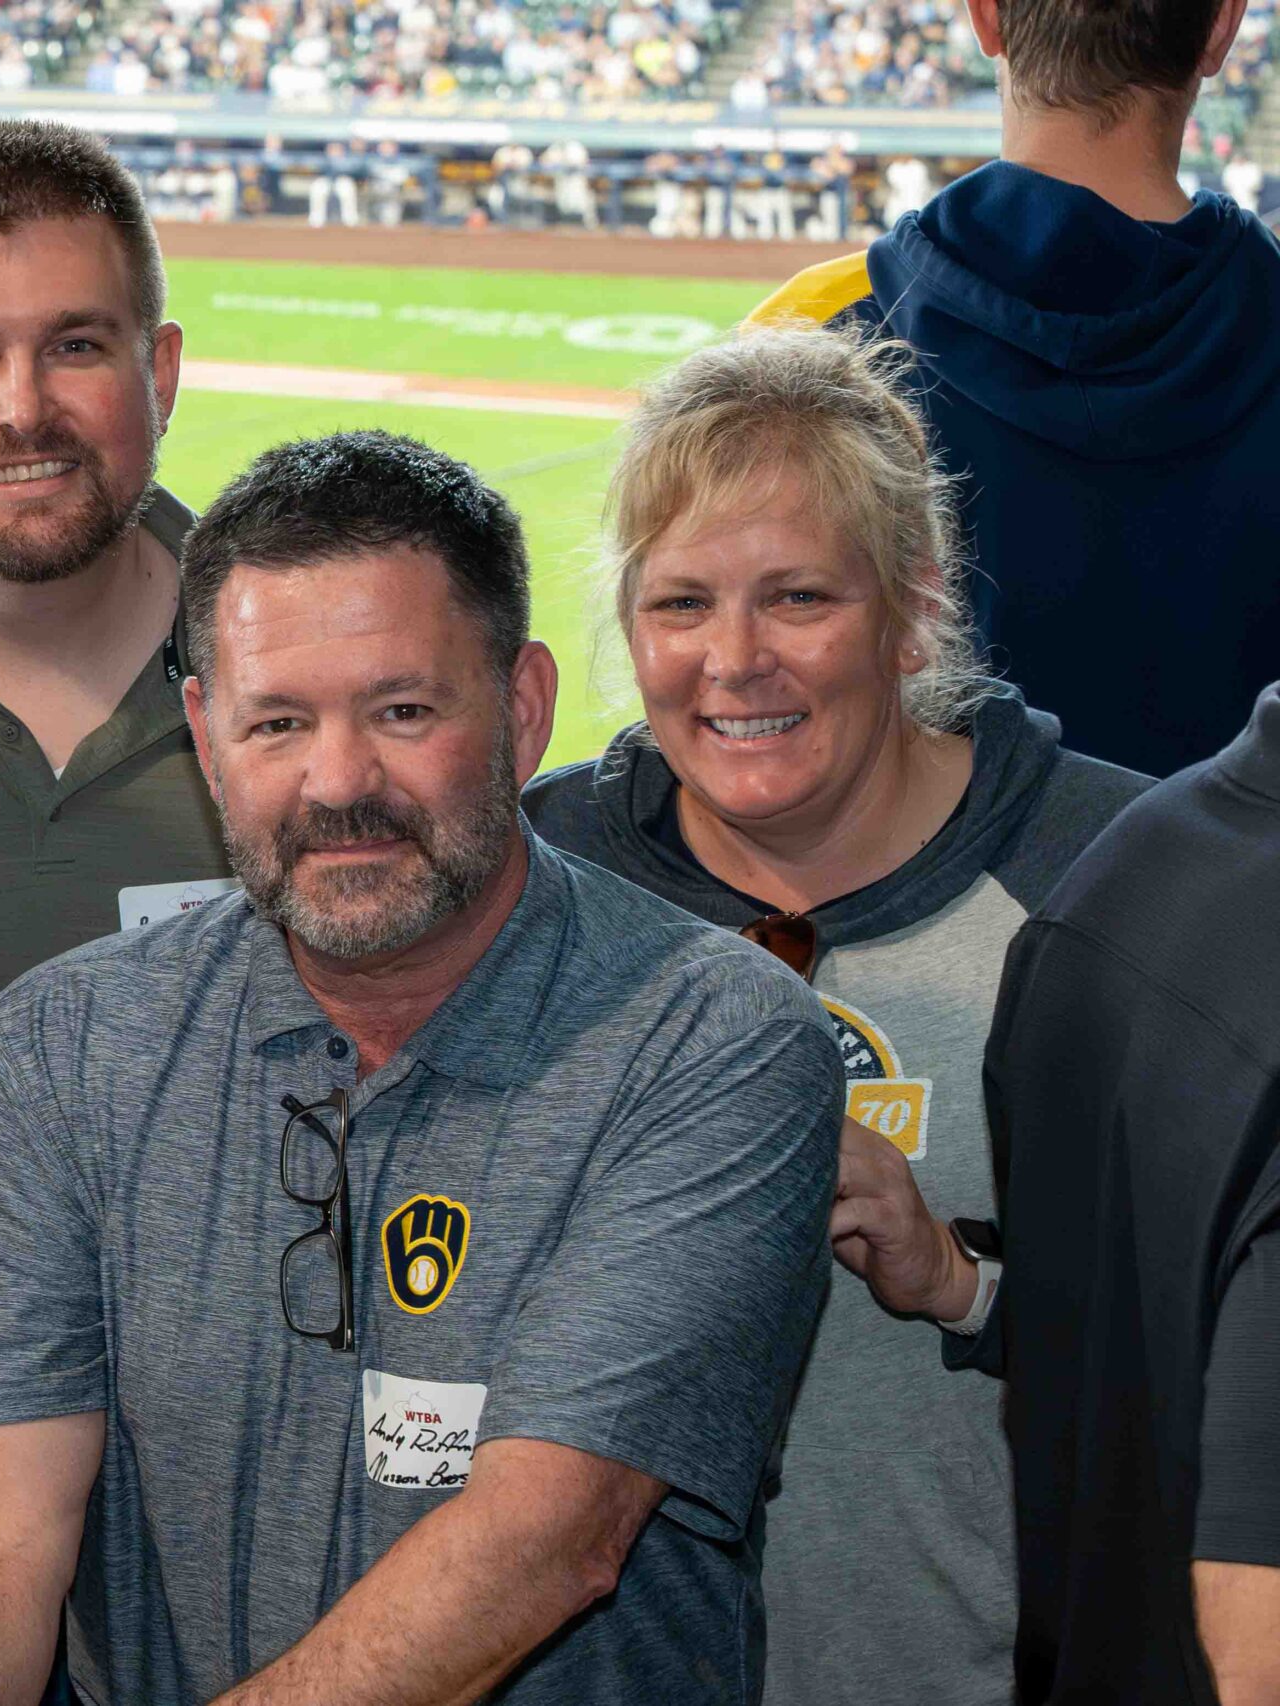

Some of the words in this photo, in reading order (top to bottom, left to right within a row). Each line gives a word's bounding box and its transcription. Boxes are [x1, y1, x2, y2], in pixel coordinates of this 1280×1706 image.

[858, 1099, 912, 1137] 70
[368, 1412, 406, 1451] Andy
[405, 1410, 442, 1424] WTBA
